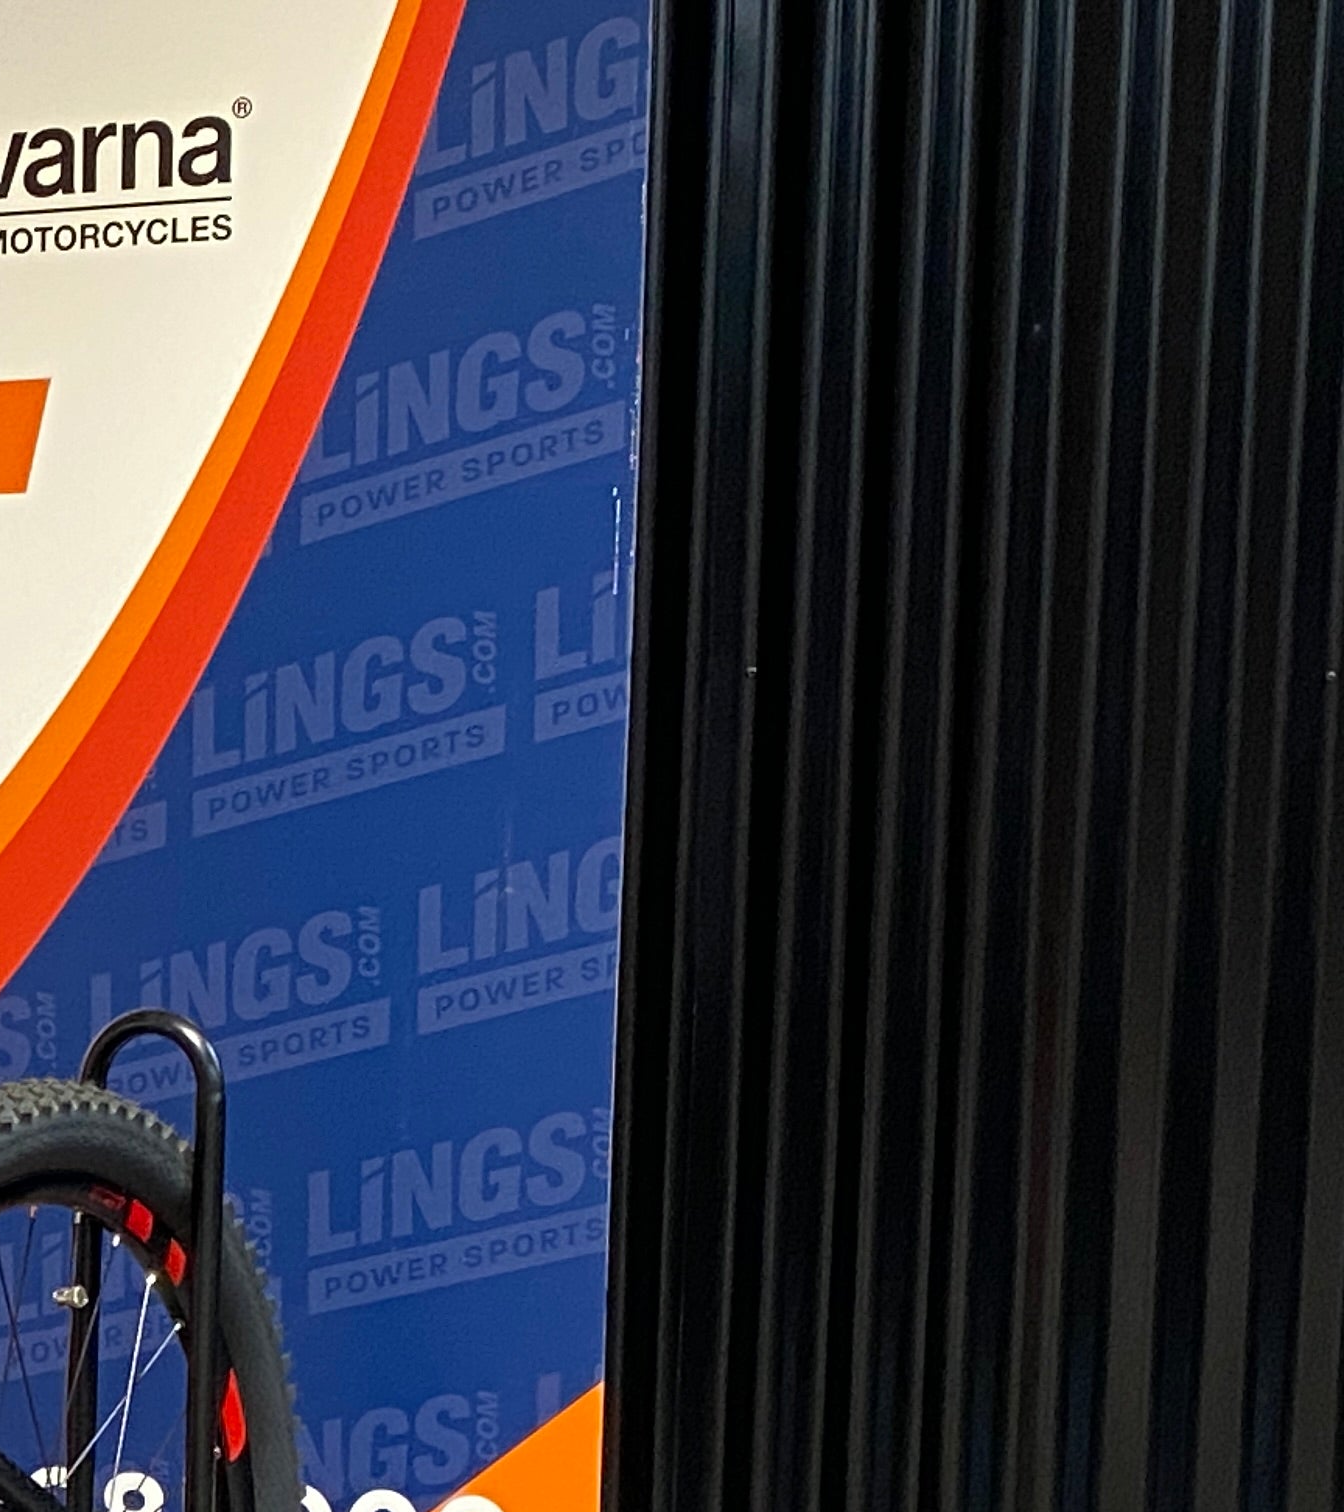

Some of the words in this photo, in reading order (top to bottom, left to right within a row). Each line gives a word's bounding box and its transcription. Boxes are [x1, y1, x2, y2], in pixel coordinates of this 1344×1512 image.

[433, 159, 562, 220] POWER
[318, 470, 445, 527] POWER
[462, 420, 604, 484] SPORTS
[209, 767, 331, 820] POWER
[346, 724, 484, 781] SPORTS
[434, 966, 565, 1019] POWER
[239, 1016, 371, 1067] SPORTS
[324, 1253, 448, 1301] POWER
[459, 1217, 605, 1269] SPORTS
